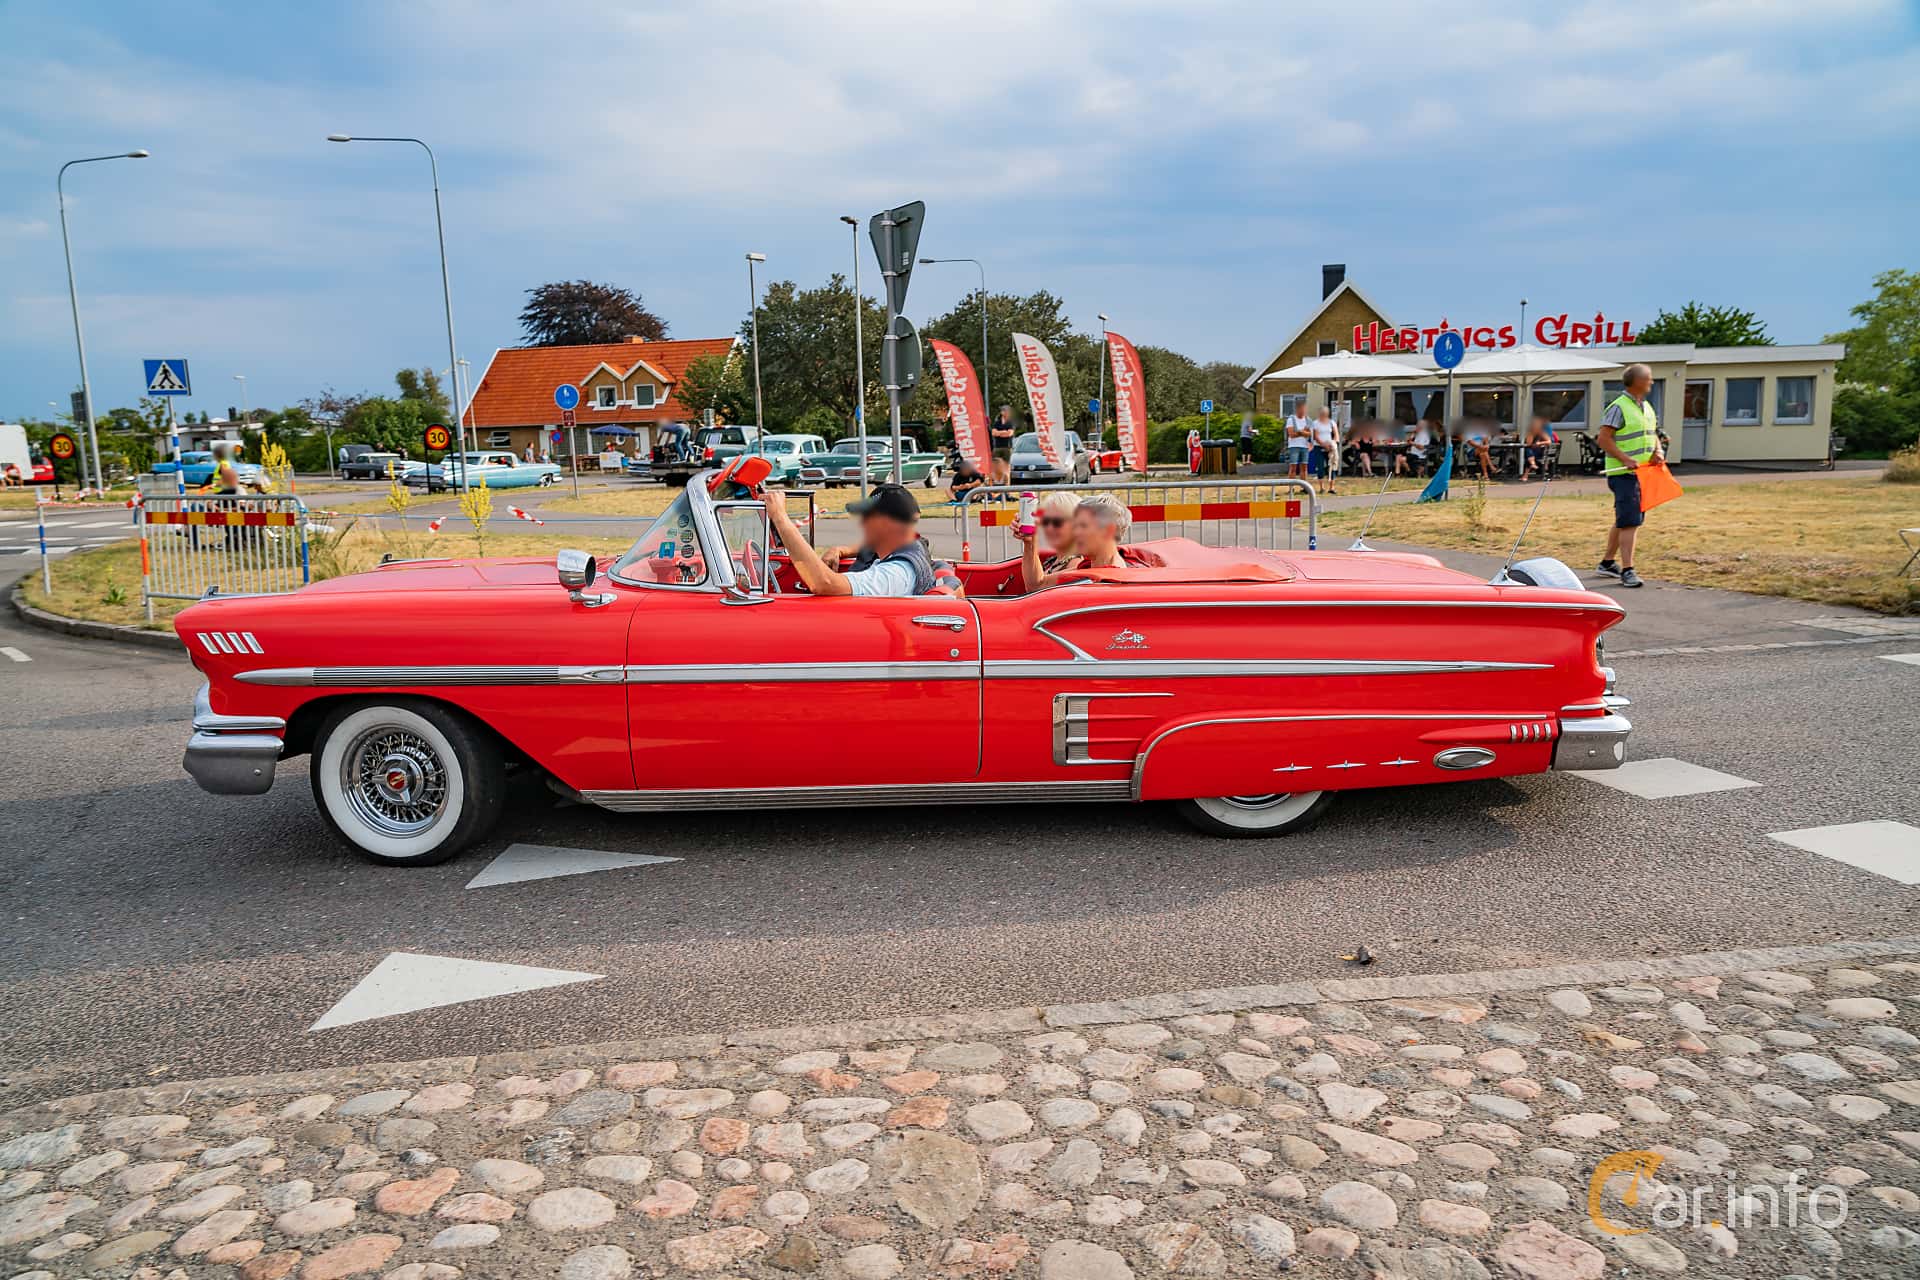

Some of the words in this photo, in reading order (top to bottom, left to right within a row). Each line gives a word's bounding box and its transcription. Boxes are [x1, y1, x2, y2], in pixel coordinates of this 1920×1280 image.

[1353, 318, 1516, 353] HERTGS
[430, 431, 446, 444] 30
[55, 440, 71, 453] 30
